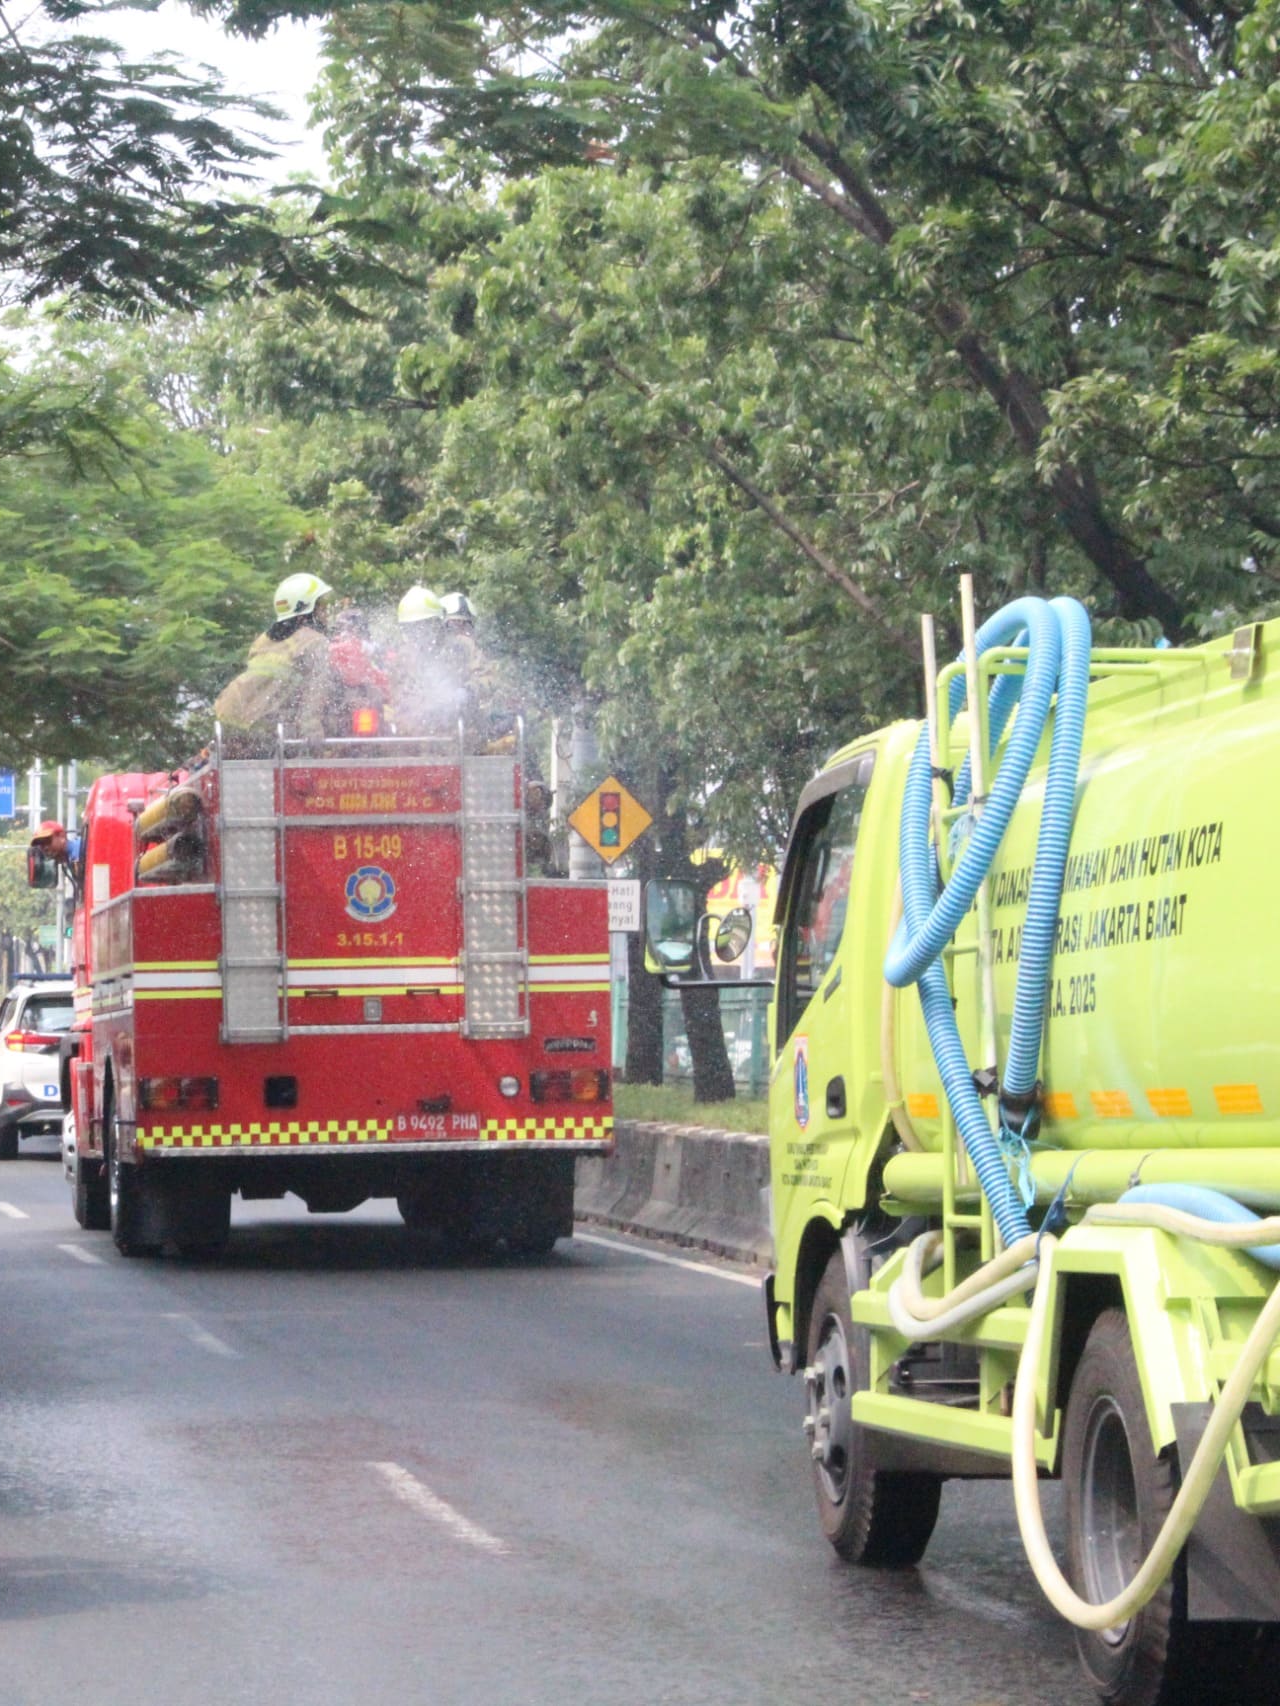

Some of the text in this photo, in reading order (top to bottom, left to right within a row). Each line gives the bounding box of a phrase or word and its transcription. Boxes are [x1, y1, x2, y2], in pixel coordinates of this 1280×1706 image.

[333, 834, 402, 859] B 15-09
[1110, 838, 1139, 884] DAN
[1138, 829, 1186, 878] HUTAN
[1185, 822, 1223, 869] KOTA
[1085, 902, 1140, 950] JAKARTA
[1145, 894, 1187, 941] BARAT
[337, 933, 404, 947] 3.15.1.1
[1070, 973, 1096, 1015] 2025
[397, 1115, 407, 1131] B
[452, 1113, 478, 1130] PHA
